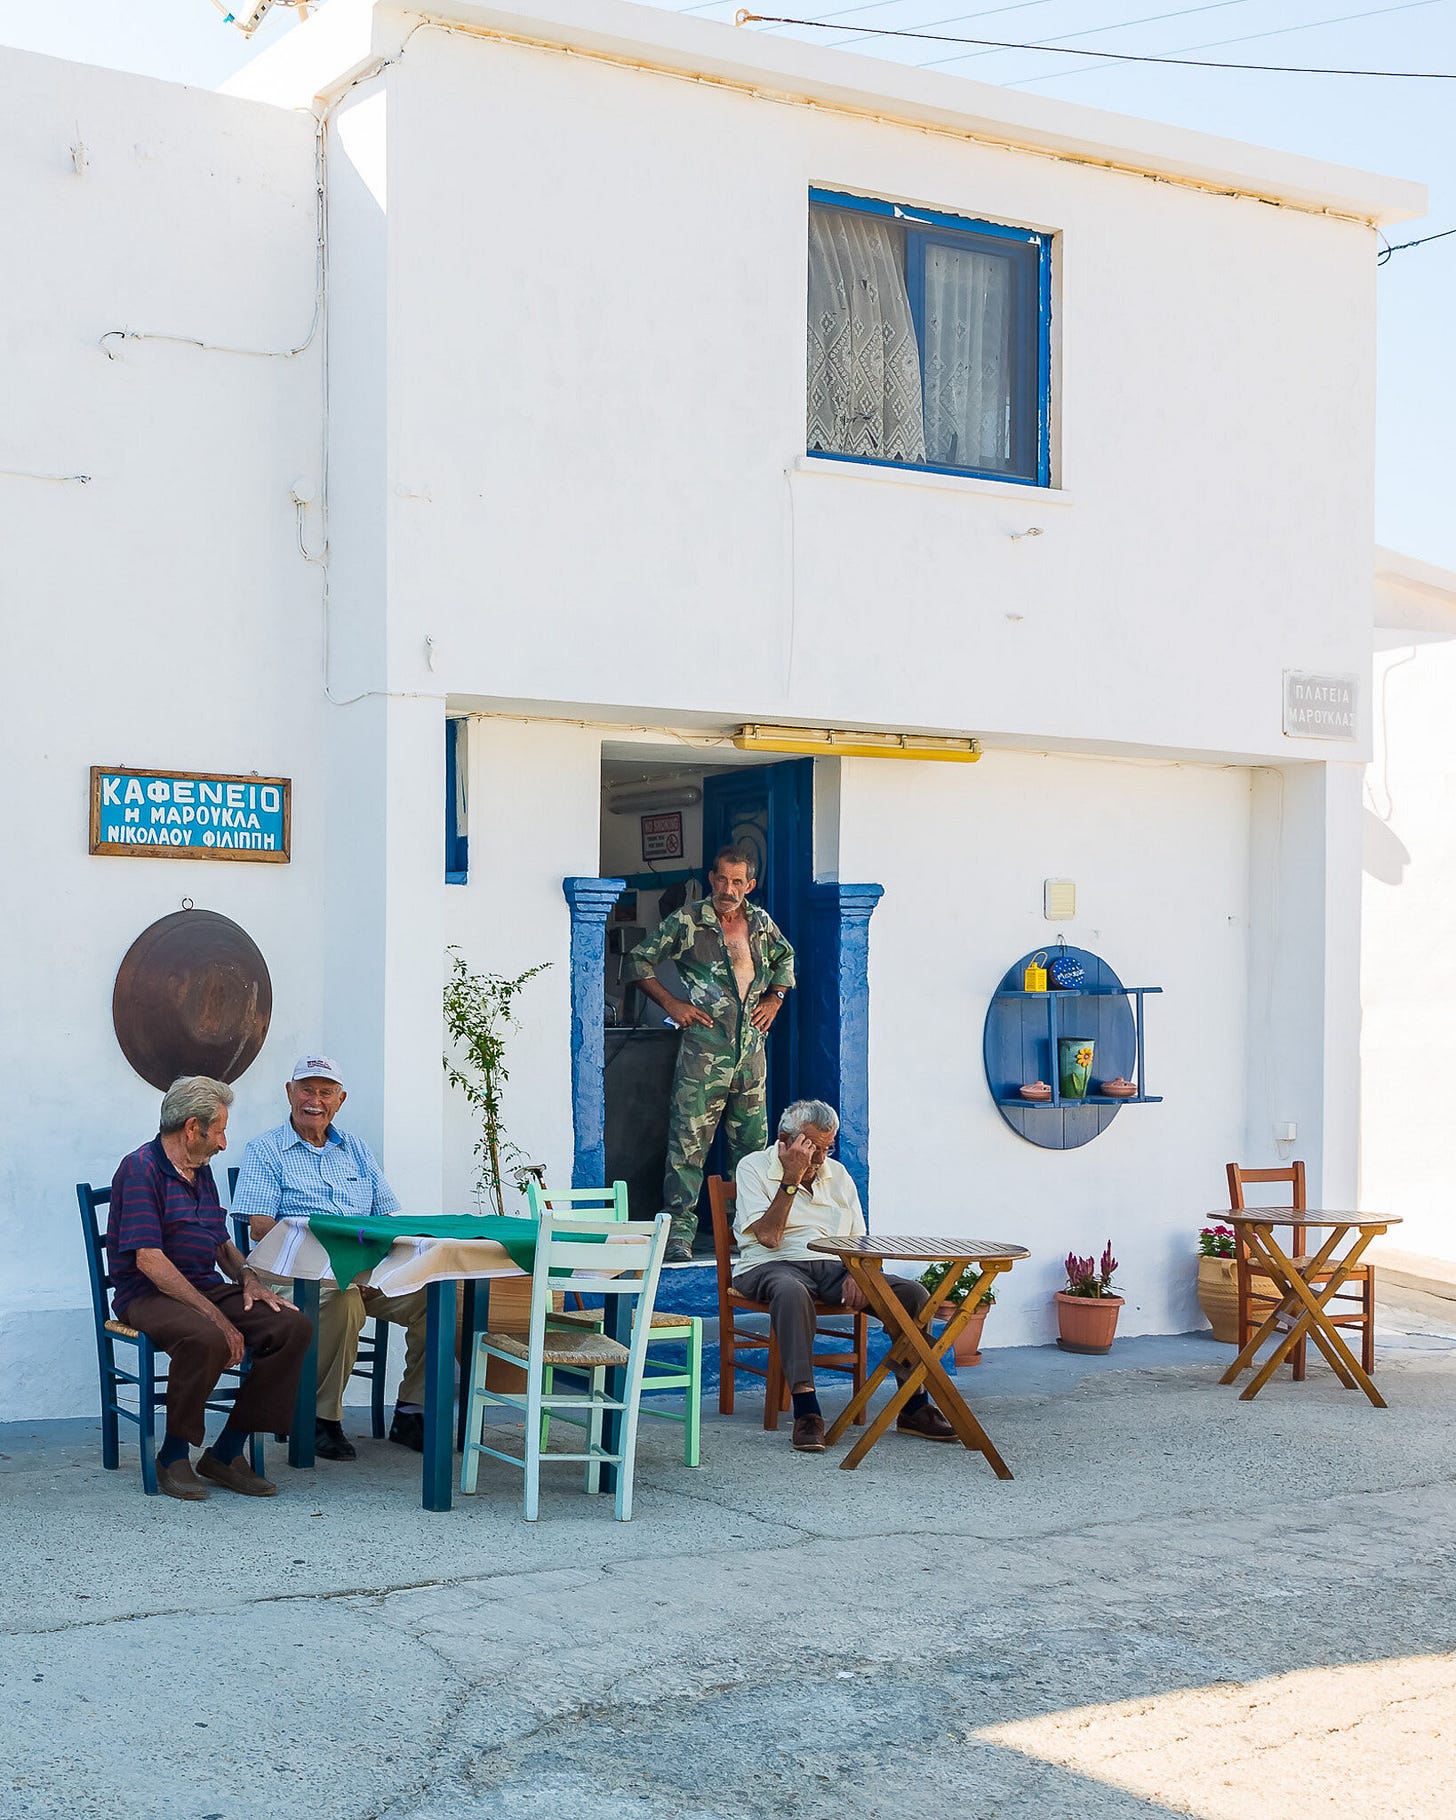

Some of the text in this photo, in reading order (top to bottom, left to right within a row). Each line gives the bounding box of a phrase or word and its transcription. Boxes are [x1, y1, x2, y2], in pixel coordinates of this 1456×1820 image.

[1295, 684, 1349, 703] ΠΛΑΤΕΙΑ
[102, 777, 280, 813] ΚΑΦΕΝΕΙΟ
[124, 806, 261, 829] Η ΜΑΡΟΥΚΛΑ
[107, 825, 275, 850] ΝΙΚΟΛΑΟΥ ΦΙΛΙΠΠΗ
